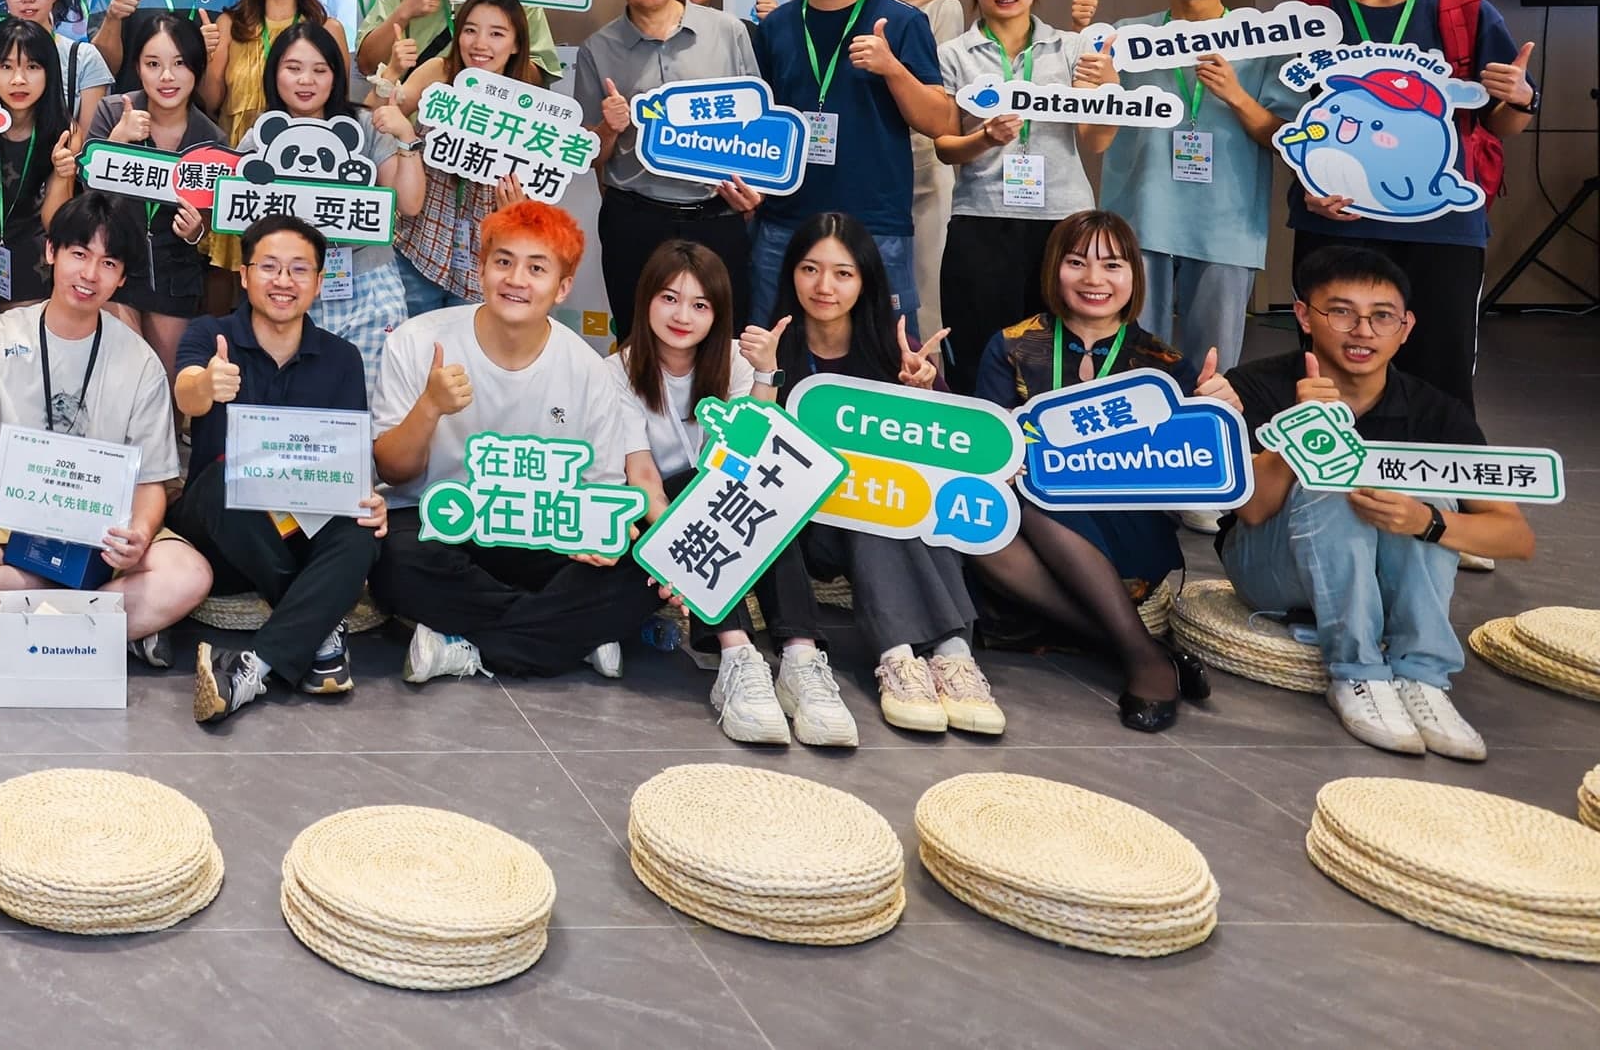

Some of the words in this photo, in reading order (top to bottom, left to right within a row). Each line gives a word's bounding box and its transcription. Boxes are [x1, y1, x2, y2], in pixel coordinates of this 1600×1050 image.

[1128, 14, 1326, 60] Datawhale
[484, 83, 510, 101] 微信
[689, 94, 736, 120] 我爱
[1011, 89, 1173, 120] Datawhale
[535, 100, 573, 120] 小程序
[425, 88, 593, 168] 微信开发者
[659, 126, 781, 160] Datawhale
[430, 131, 565, 198] 创新工坊
[227, 190, 297, 222] 成都
[313, 195, 381, 232] 耍起
[835, 405, 971, 454] Create
[1069, 395, 1138, 436] 我爱
[289, 434, 310, 443] 2026
[55, 459, 76, 469] 2026
[476, 443, 583, 483] 在跑了
[1043, 442, 1213, 474] Datawhale
[1377, 457, 1538, 487] 做个小程序
[69, 470, 102, 485] 创新工坊
[244, 466, 274, 479] NO.3
[278, 468, 355, 484] 人气新锐摊位
[830, 469, 906, 510] ith
[5, 486, 36, 502] NO.2
[39, 492, 114, 517] 人气先锋摊位
[476, 484, 638, 546] 在跑了
[667, 434, 813, 590] 赞赏+1
[948, 493, 994, 527] AI
[41, 645, 97, 656] Datawhale
